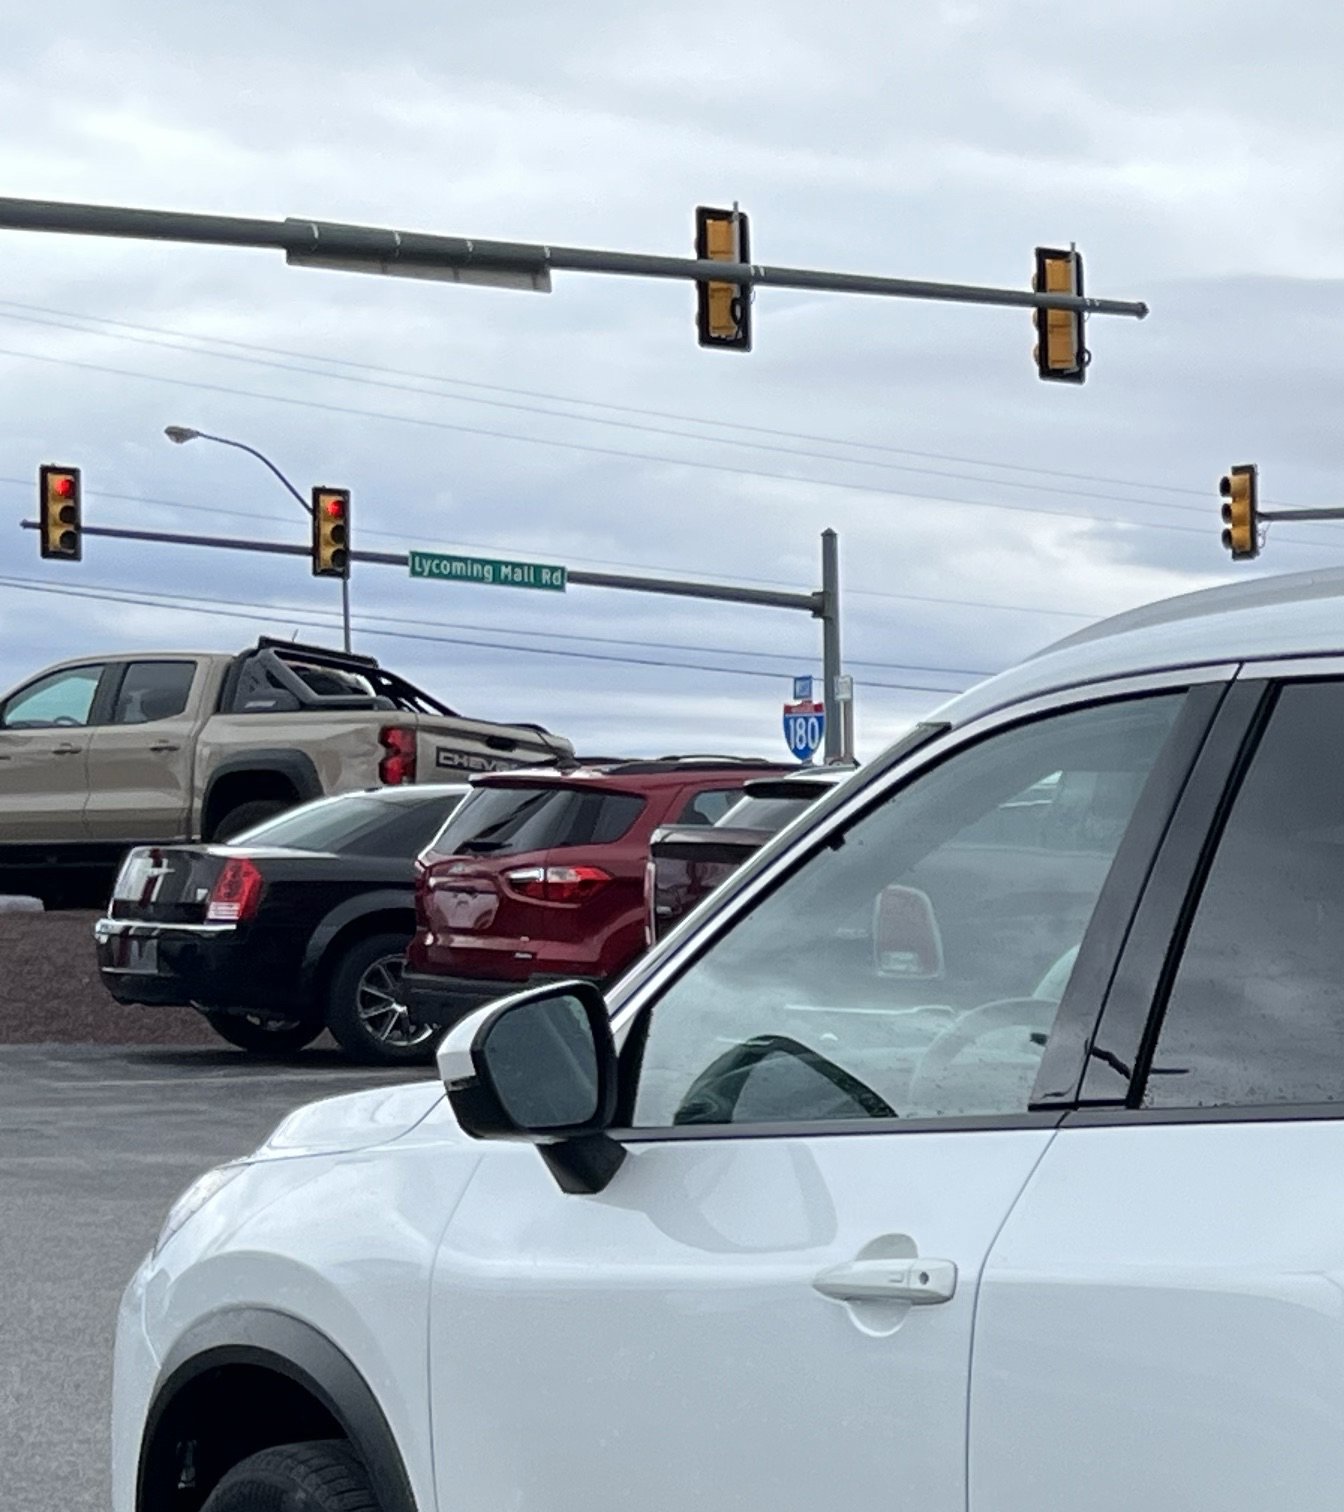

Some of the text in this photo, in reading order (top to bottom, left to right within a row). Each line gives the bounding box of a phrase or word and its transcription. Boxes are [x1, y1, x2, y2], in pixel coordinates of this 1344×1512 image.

[415, 555, 562, 585] Lycoming Mall Rd
[789, 717, 820, 750] 180
